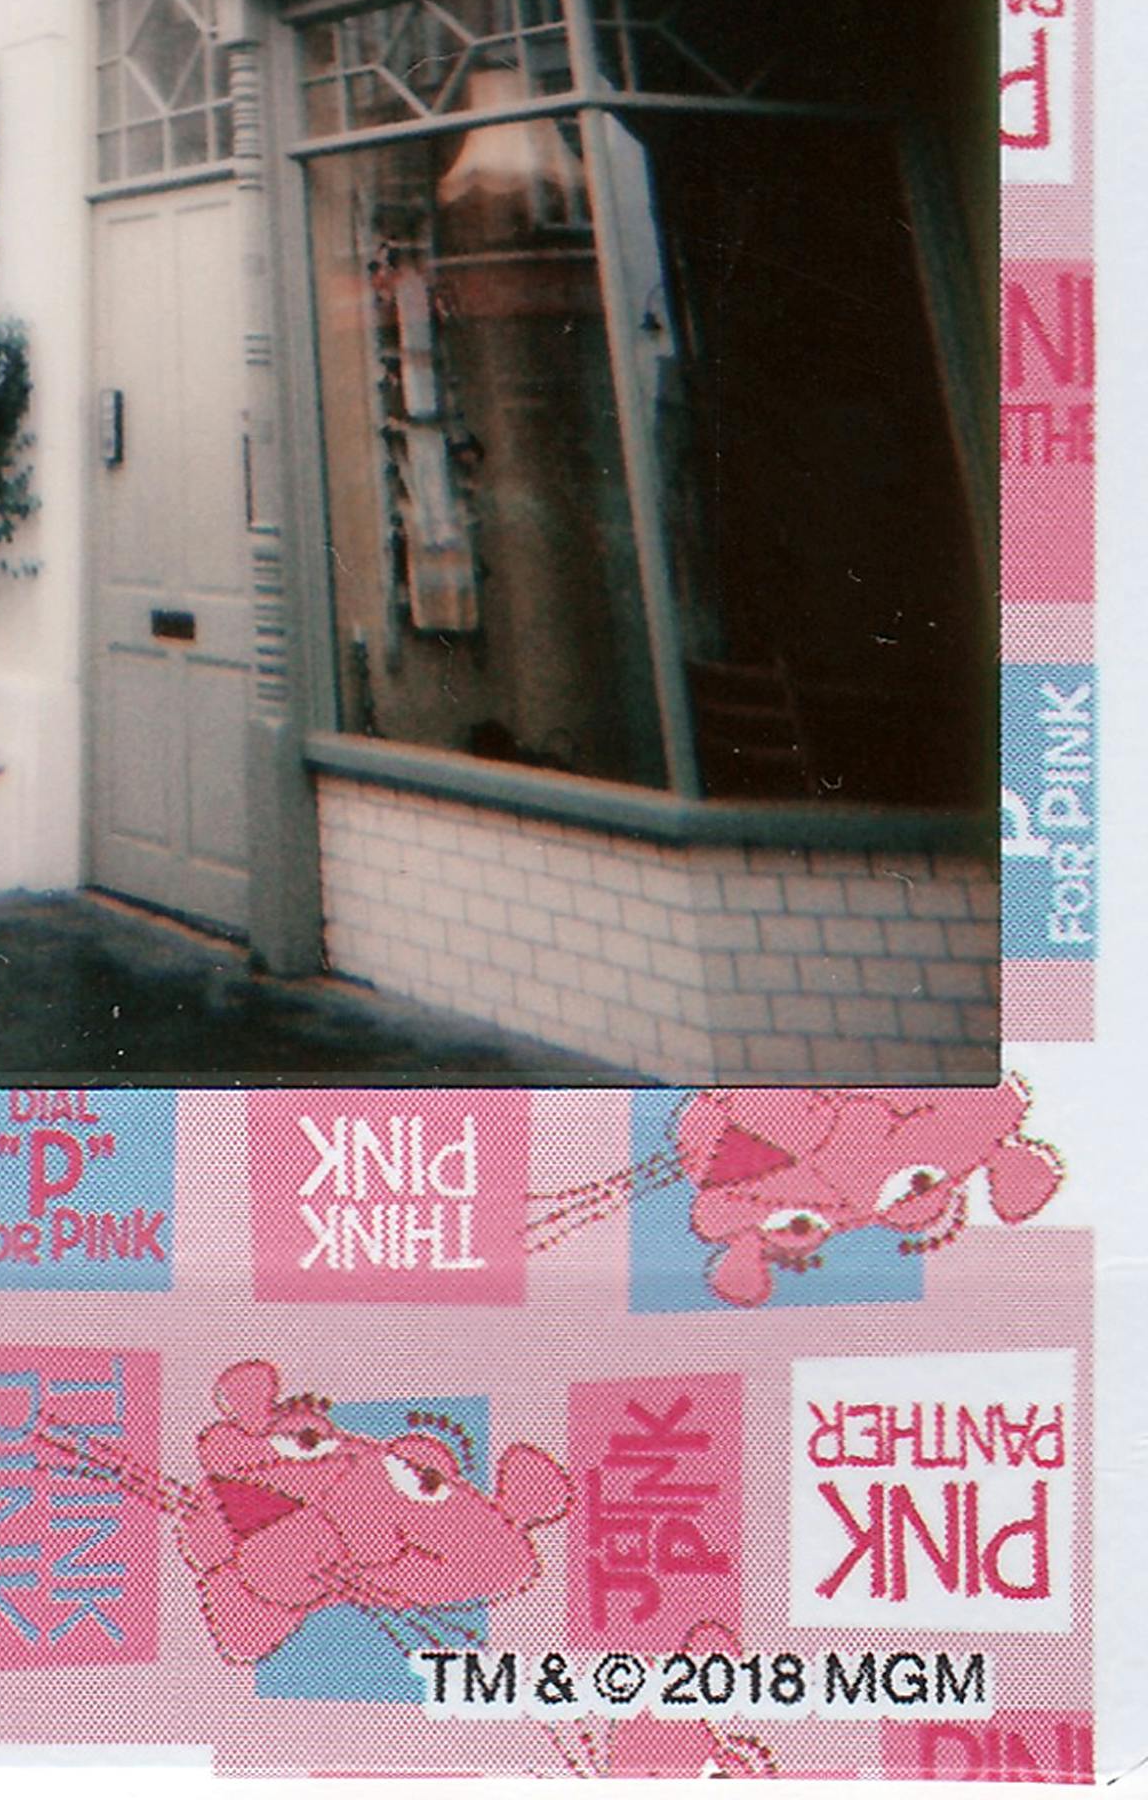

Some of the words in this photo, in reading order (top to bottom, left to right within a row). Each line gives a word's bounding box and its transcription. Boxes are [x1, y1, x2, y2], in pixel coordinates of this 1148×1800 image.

[1038, 683, 1092, 826] PINK
[1049, 841, 1093, 942] FOR
[298, 1114, 476, 1200] PINK
[52, 1207, 165, 1263] PINK
[299, 1204, 485, 1270] THINK
[807, 1400, 1064, 1470] PANTHER
[48, 1356, 126, 1643] THINK
[602, 1395, 730, 1576] PINK
[815, 1479, 1050, 1602] PINK
[420, 1652, 517, 1704] TM
[535, 1653, 574, 1705] &
[593, 1653, 644, 1705] ©
[660, 1652, 804, 1705] 2018
[826, 1652, 986, 1705] MGM
